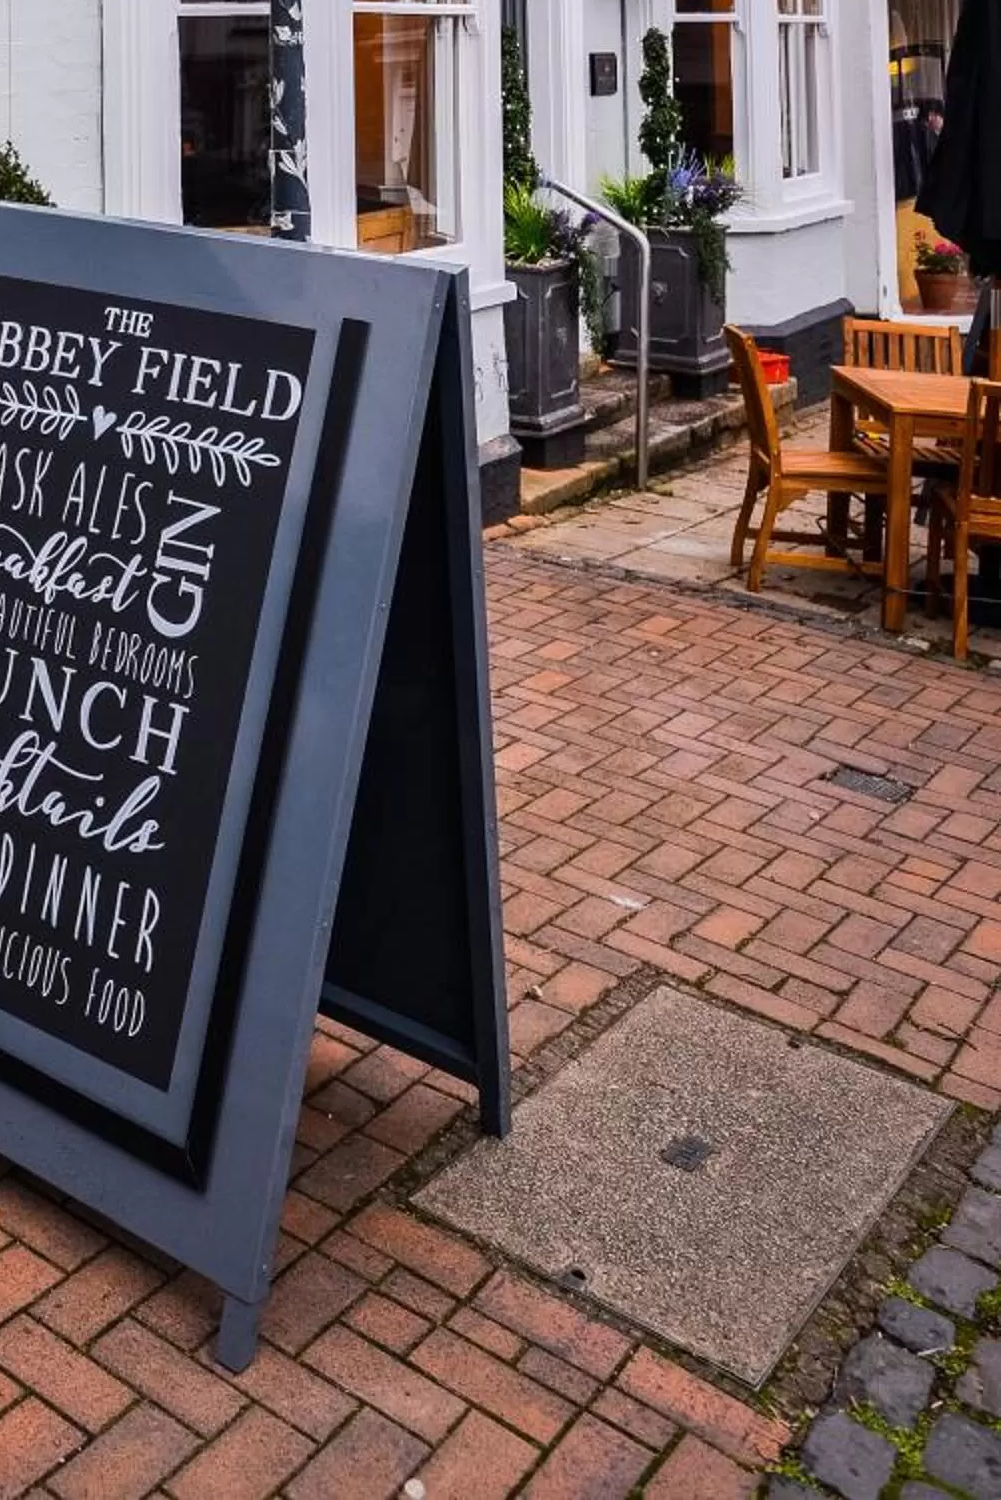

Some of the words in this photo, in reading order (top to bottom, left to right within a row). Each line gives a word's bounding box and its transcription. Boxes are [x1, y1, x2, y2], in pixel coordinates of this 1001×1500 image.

[104, 307, 154, 338] THE
[131, 347, 302, 421] FIELD
[62, 462, 153, 546] ALES
[147, 489, 222, 638] GIN
[88, 621, 199, 699] BEDROOMS
[85, 967, 146, 1037] FOOD
